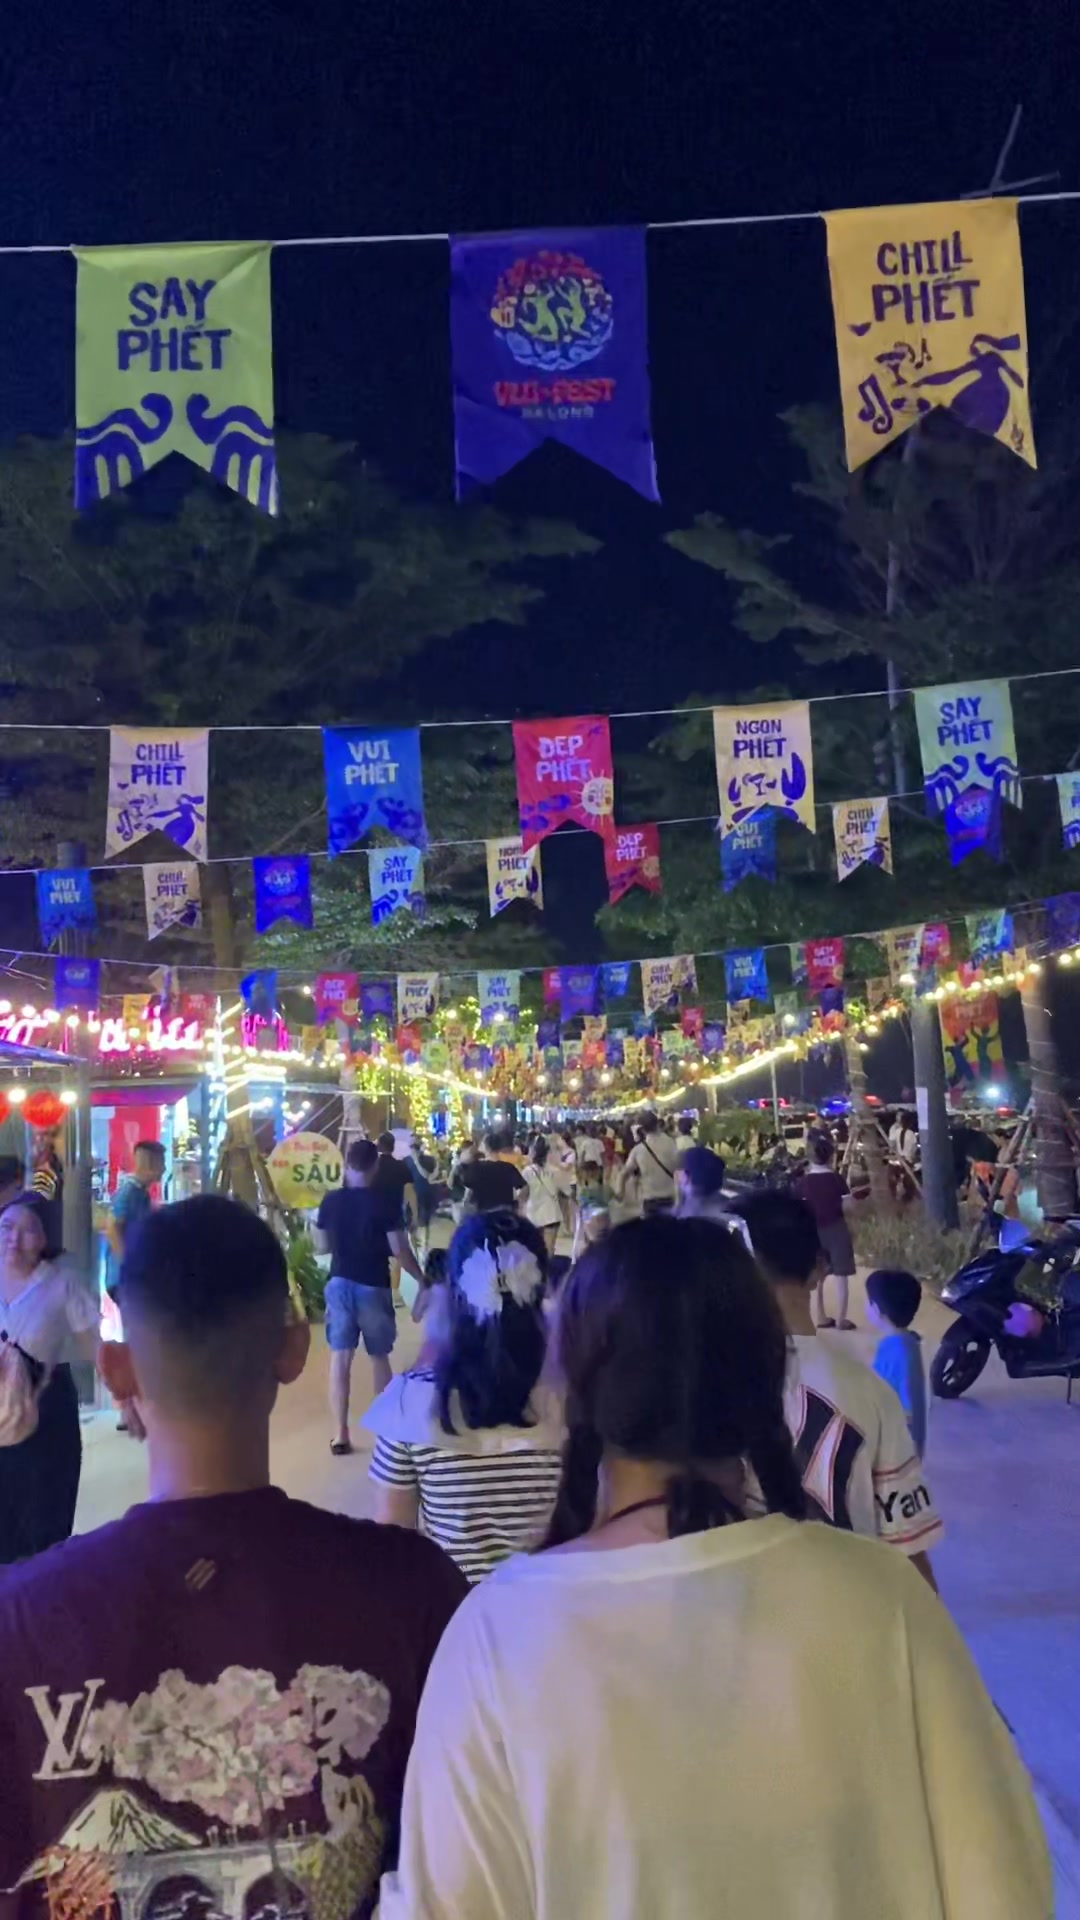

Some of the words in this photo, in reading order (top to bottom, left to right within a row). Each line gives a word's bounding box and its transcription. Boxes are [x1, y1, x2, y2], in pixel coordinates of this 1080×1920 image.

[876, 230, 973, 276] CHILL
[128, 276, 217, 327] SAY
[939, 696, 982, 726] SAY
[735, 718, 783, 735] NGON
[135, 741, 184, 762] CHILL
[346, 739, 391, 763] VUI
[383, 855, 408, 871] SAY
[874, 1484, 932, 1524] Yan
